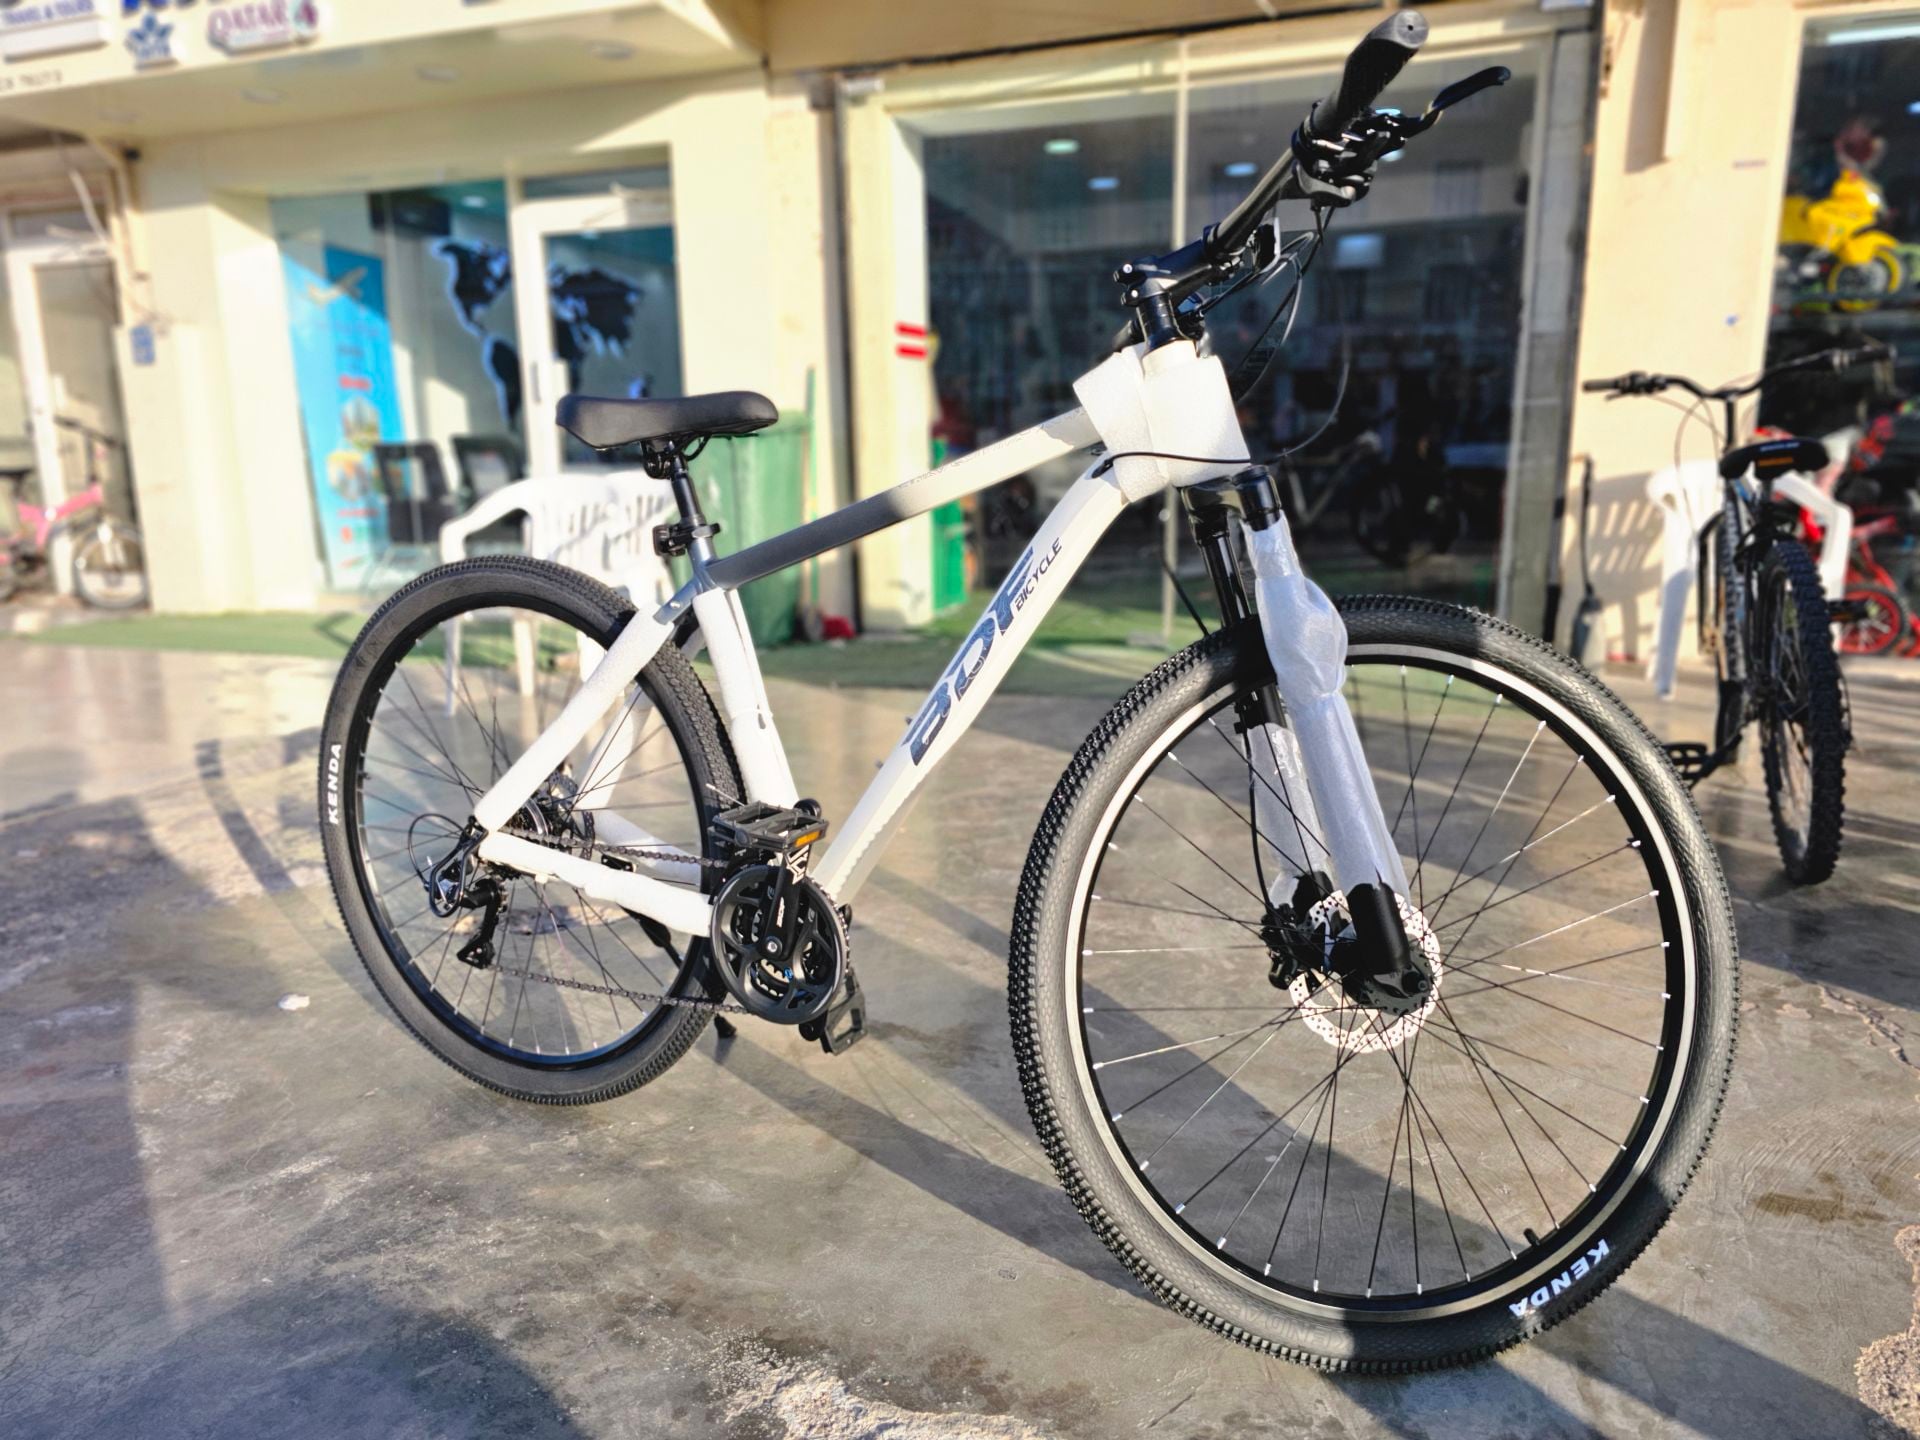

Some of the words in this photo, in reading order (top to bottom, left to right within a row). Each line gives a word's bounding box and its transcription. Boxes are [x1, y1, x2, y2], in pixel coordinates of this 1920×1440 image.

[1016, 537, 1062, 611] BICYCLE
[901, 547, 1034, 766] BDF
[328, 744, 341, 824] KENDA
[1509, 1239, 1610, 1317] KENDA
